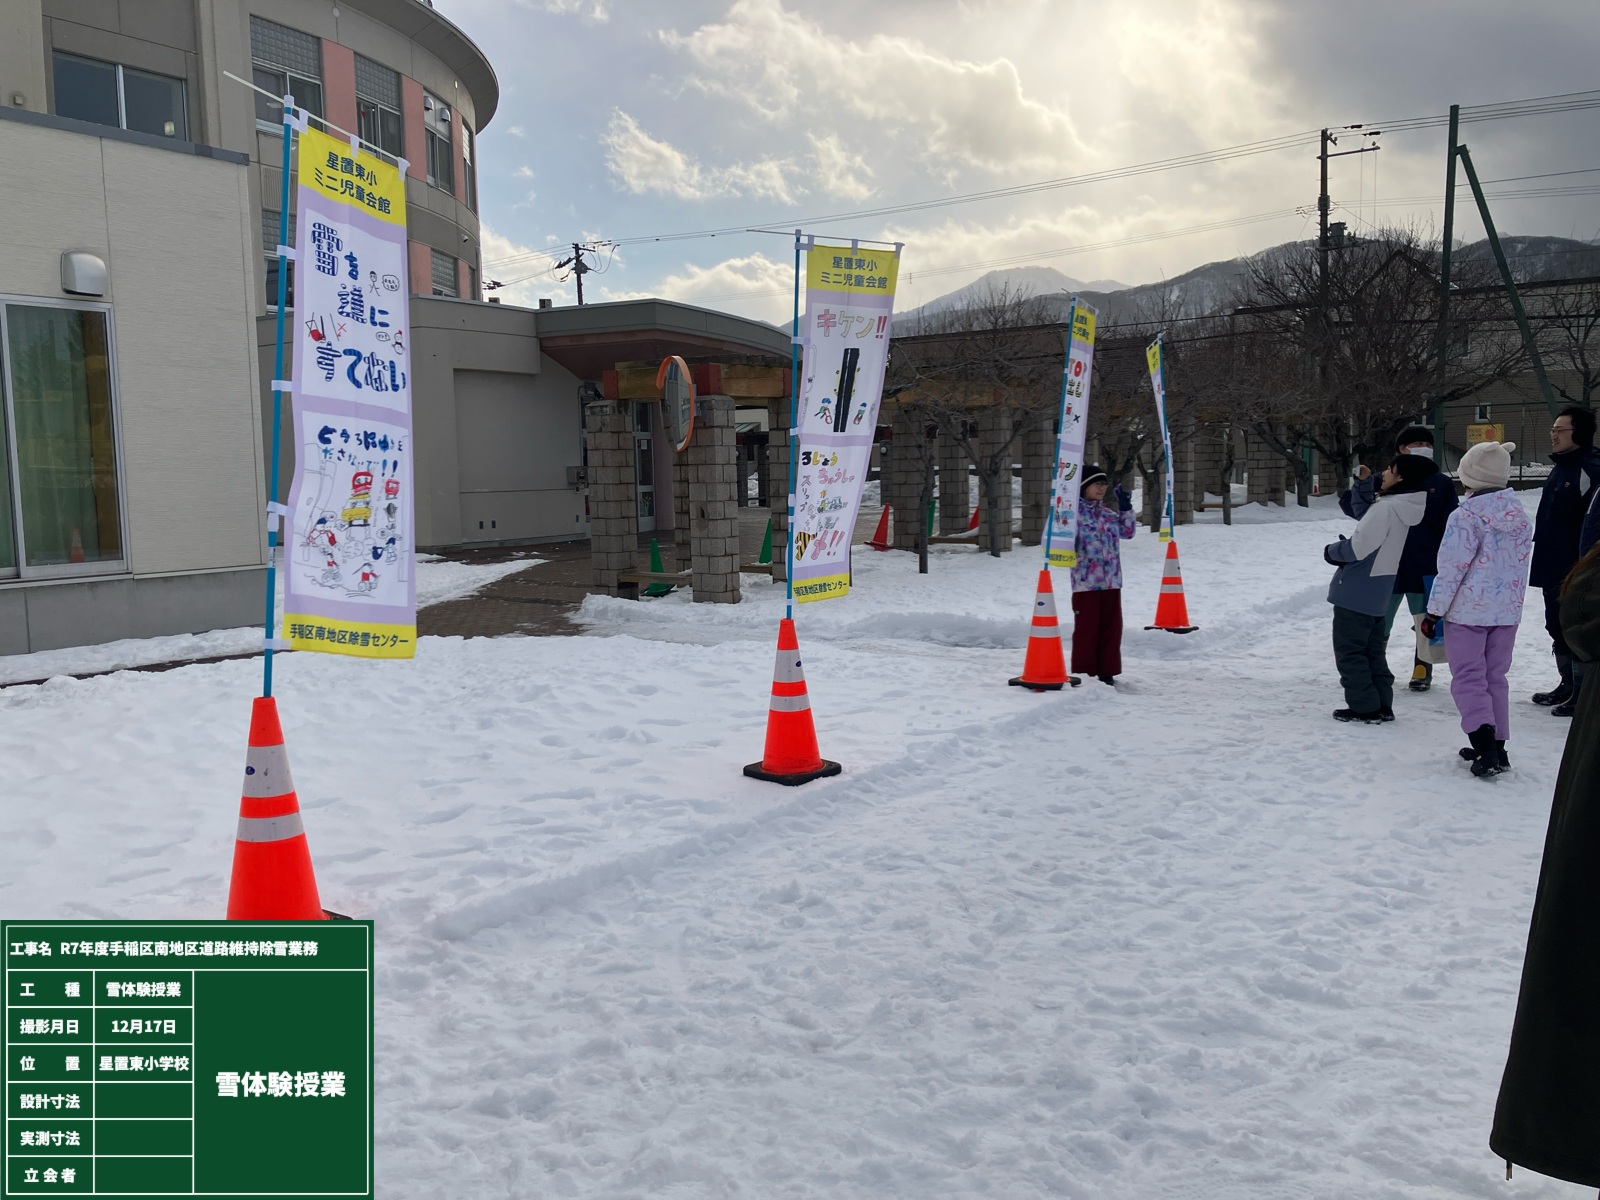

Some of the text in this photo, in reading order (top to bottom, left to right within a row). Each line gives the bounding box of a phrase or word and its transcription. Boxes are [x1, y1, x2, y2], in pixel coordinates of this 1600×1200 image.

[326, 151, 378, 187] 星置東小
[314, 167, 391, 215] ミニ児童会館
[832, 256, 878, 272] 星置東小
[820, 271, 888, 289] ミニ児童会館
[316, 340, 407, 393] すてない
[801, 450, 839, 467] ろじょう
[817, 467, 855, 486] ちゅうしゃ
[794, 529, 846, 562] ダメ!!
[289, 623, 409, 649] 手稲区南地区除雪センター
